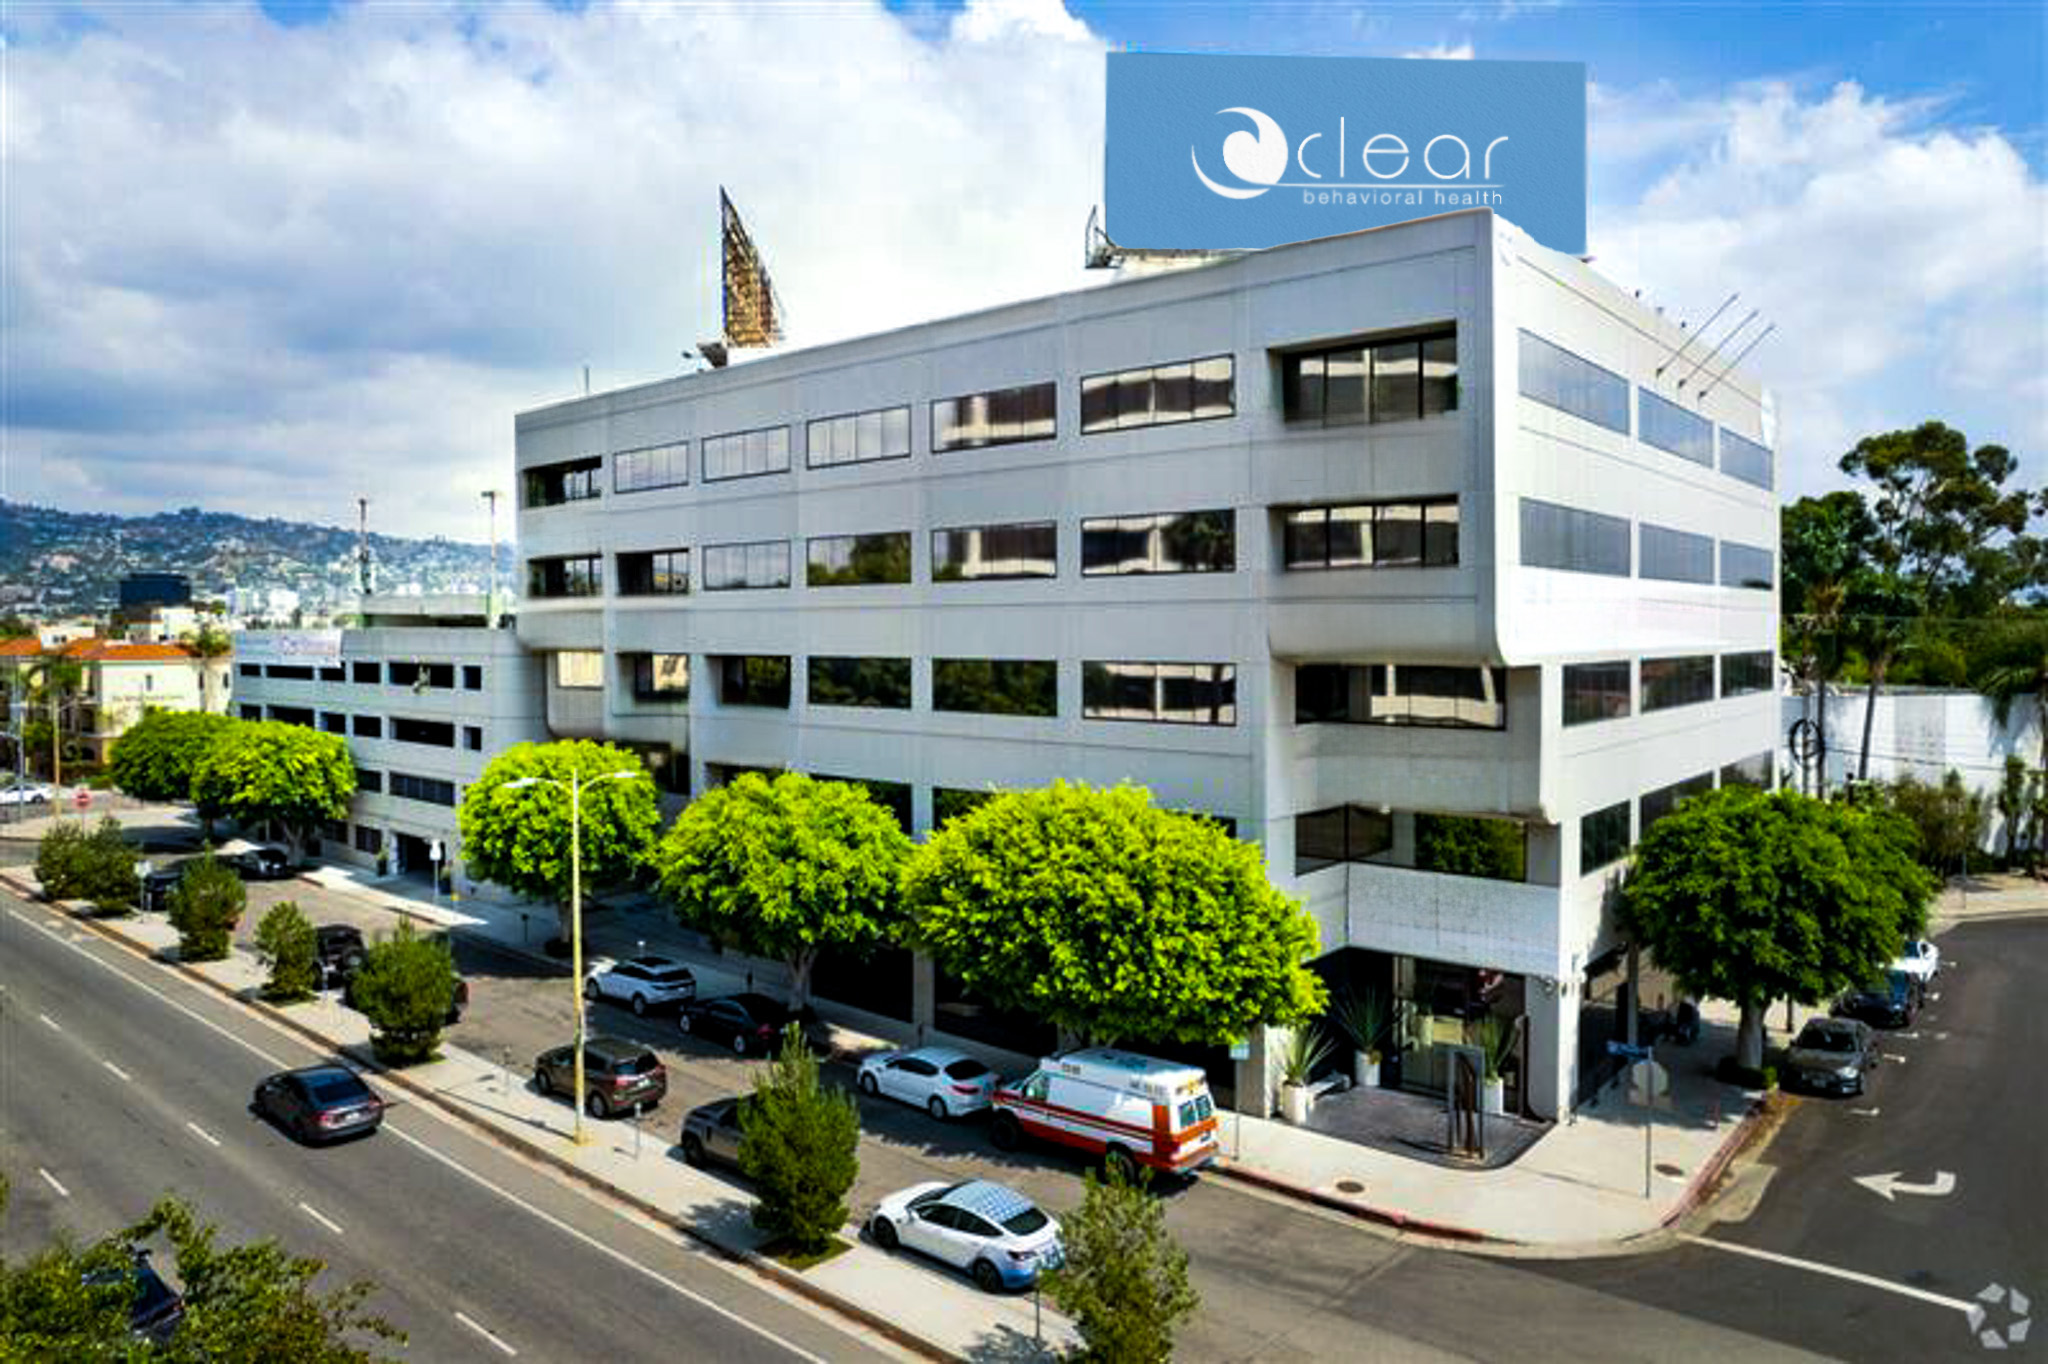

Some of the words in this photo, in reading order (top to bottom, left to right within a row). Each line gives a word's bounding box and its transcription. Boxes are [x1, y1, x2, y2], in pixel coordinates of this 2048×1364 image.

[1297, 116, 1509, 180] clear
[1303, 189, 1423, 205] behavioral
[1435, 190, 1503, 205] health
